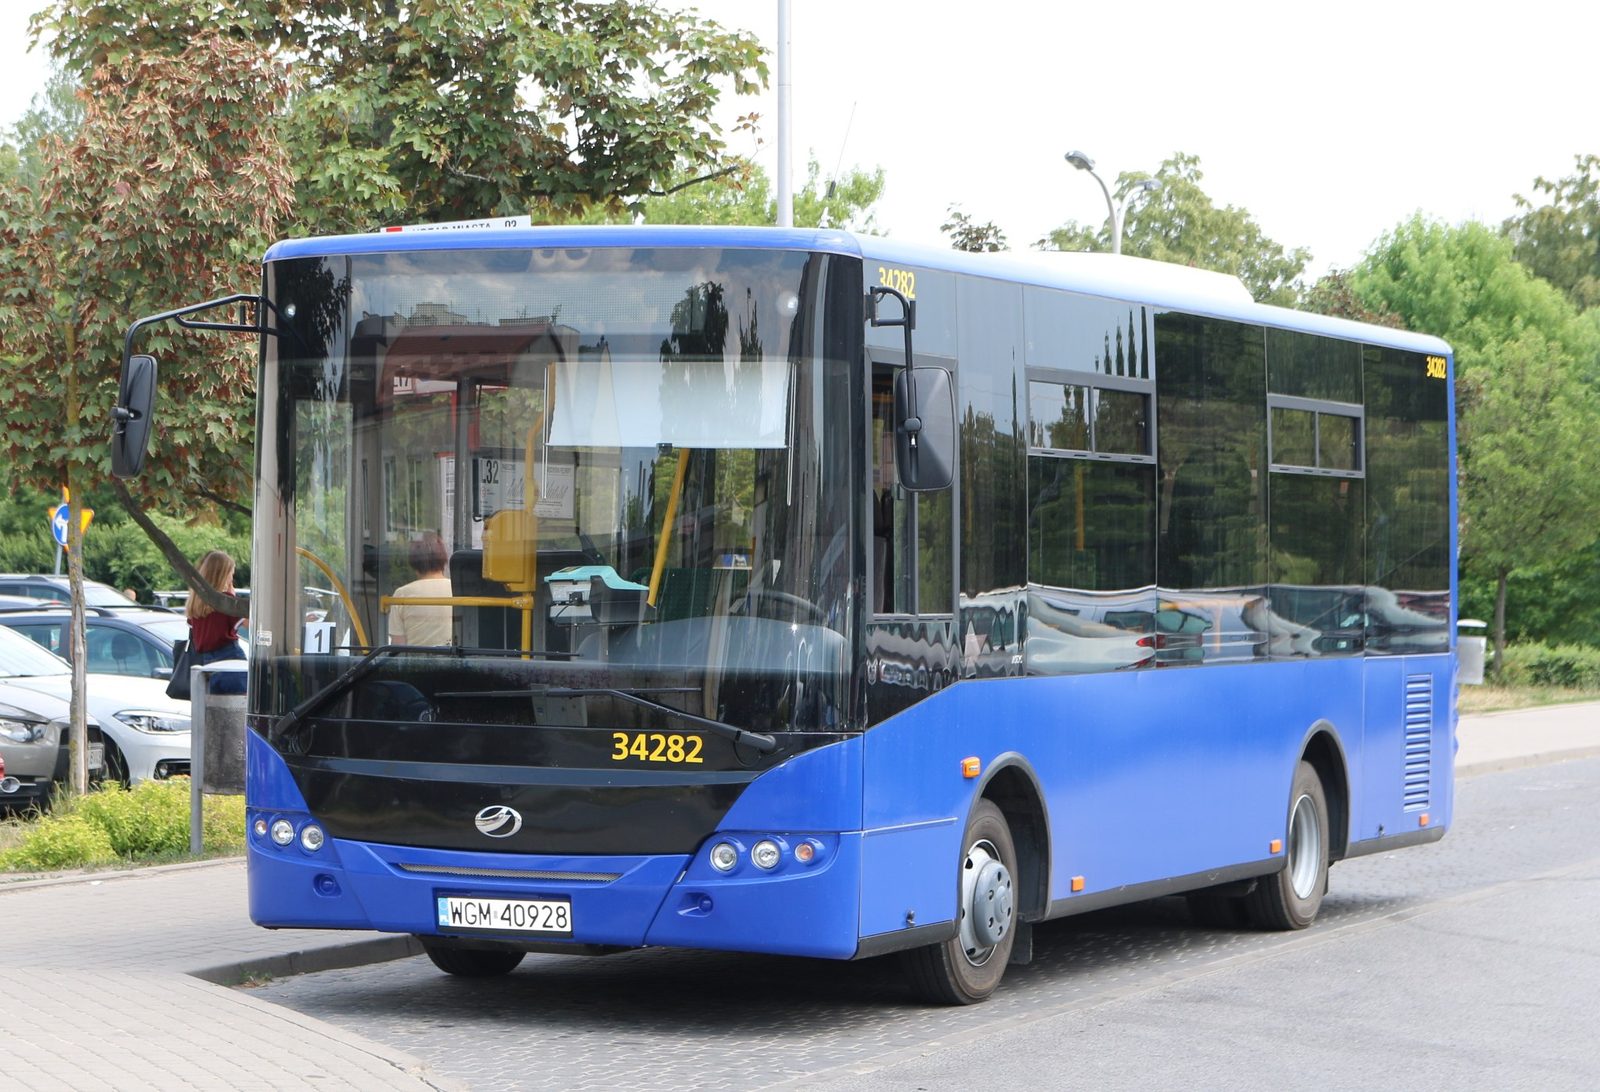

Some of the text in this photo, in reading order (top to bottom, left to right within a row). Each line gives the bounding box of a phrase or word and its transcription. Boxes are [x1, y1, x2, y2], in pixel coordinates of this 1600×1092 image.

[878, 266, 916, 299] 34282
[314, 628, 323, 653] 1
[611, 732, 704, 764] 34282
[450, 900, 568, 929] WGM 40928
